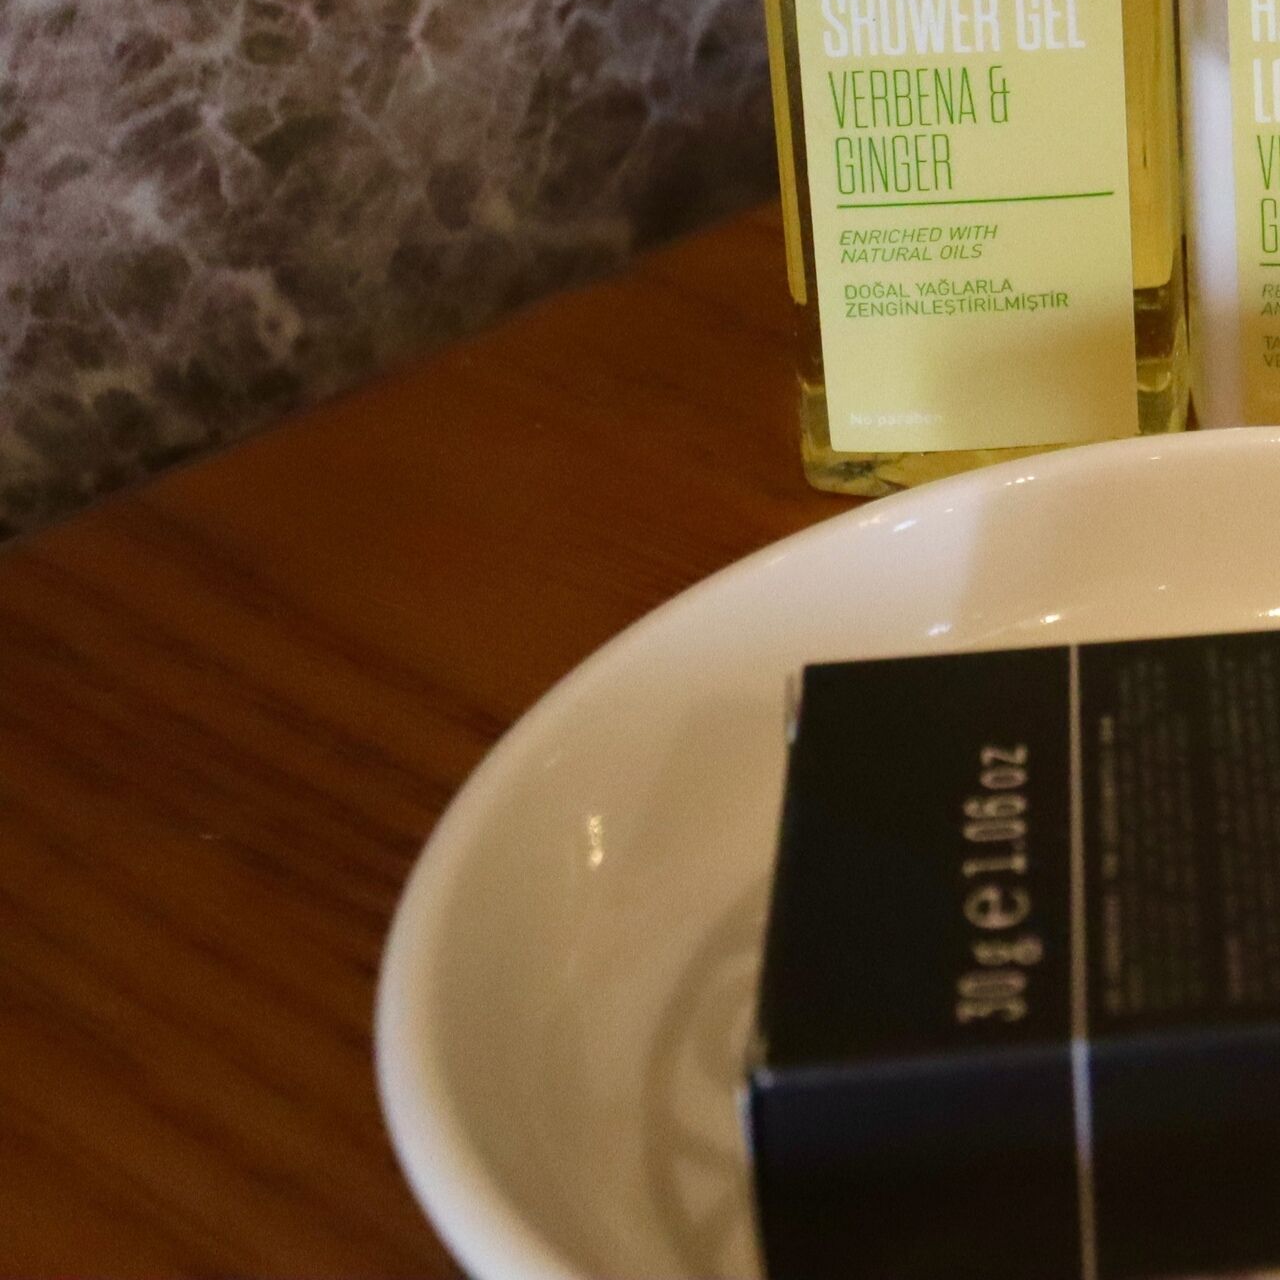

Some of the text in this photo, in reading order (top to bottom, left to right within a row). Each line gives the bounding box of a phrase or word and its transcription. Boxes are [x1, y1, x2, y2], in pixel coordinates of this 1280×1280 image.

[828, 65, 1010, 129] VERBENA &
[835, 133, 952, 195] GINGER
[839, 224, 998, 246] ENRICHED WITH
[840, 244, 983, 264] NATURAL OILS
[844, 278, 1013, 300] DOĞAL YAĞLARLA
